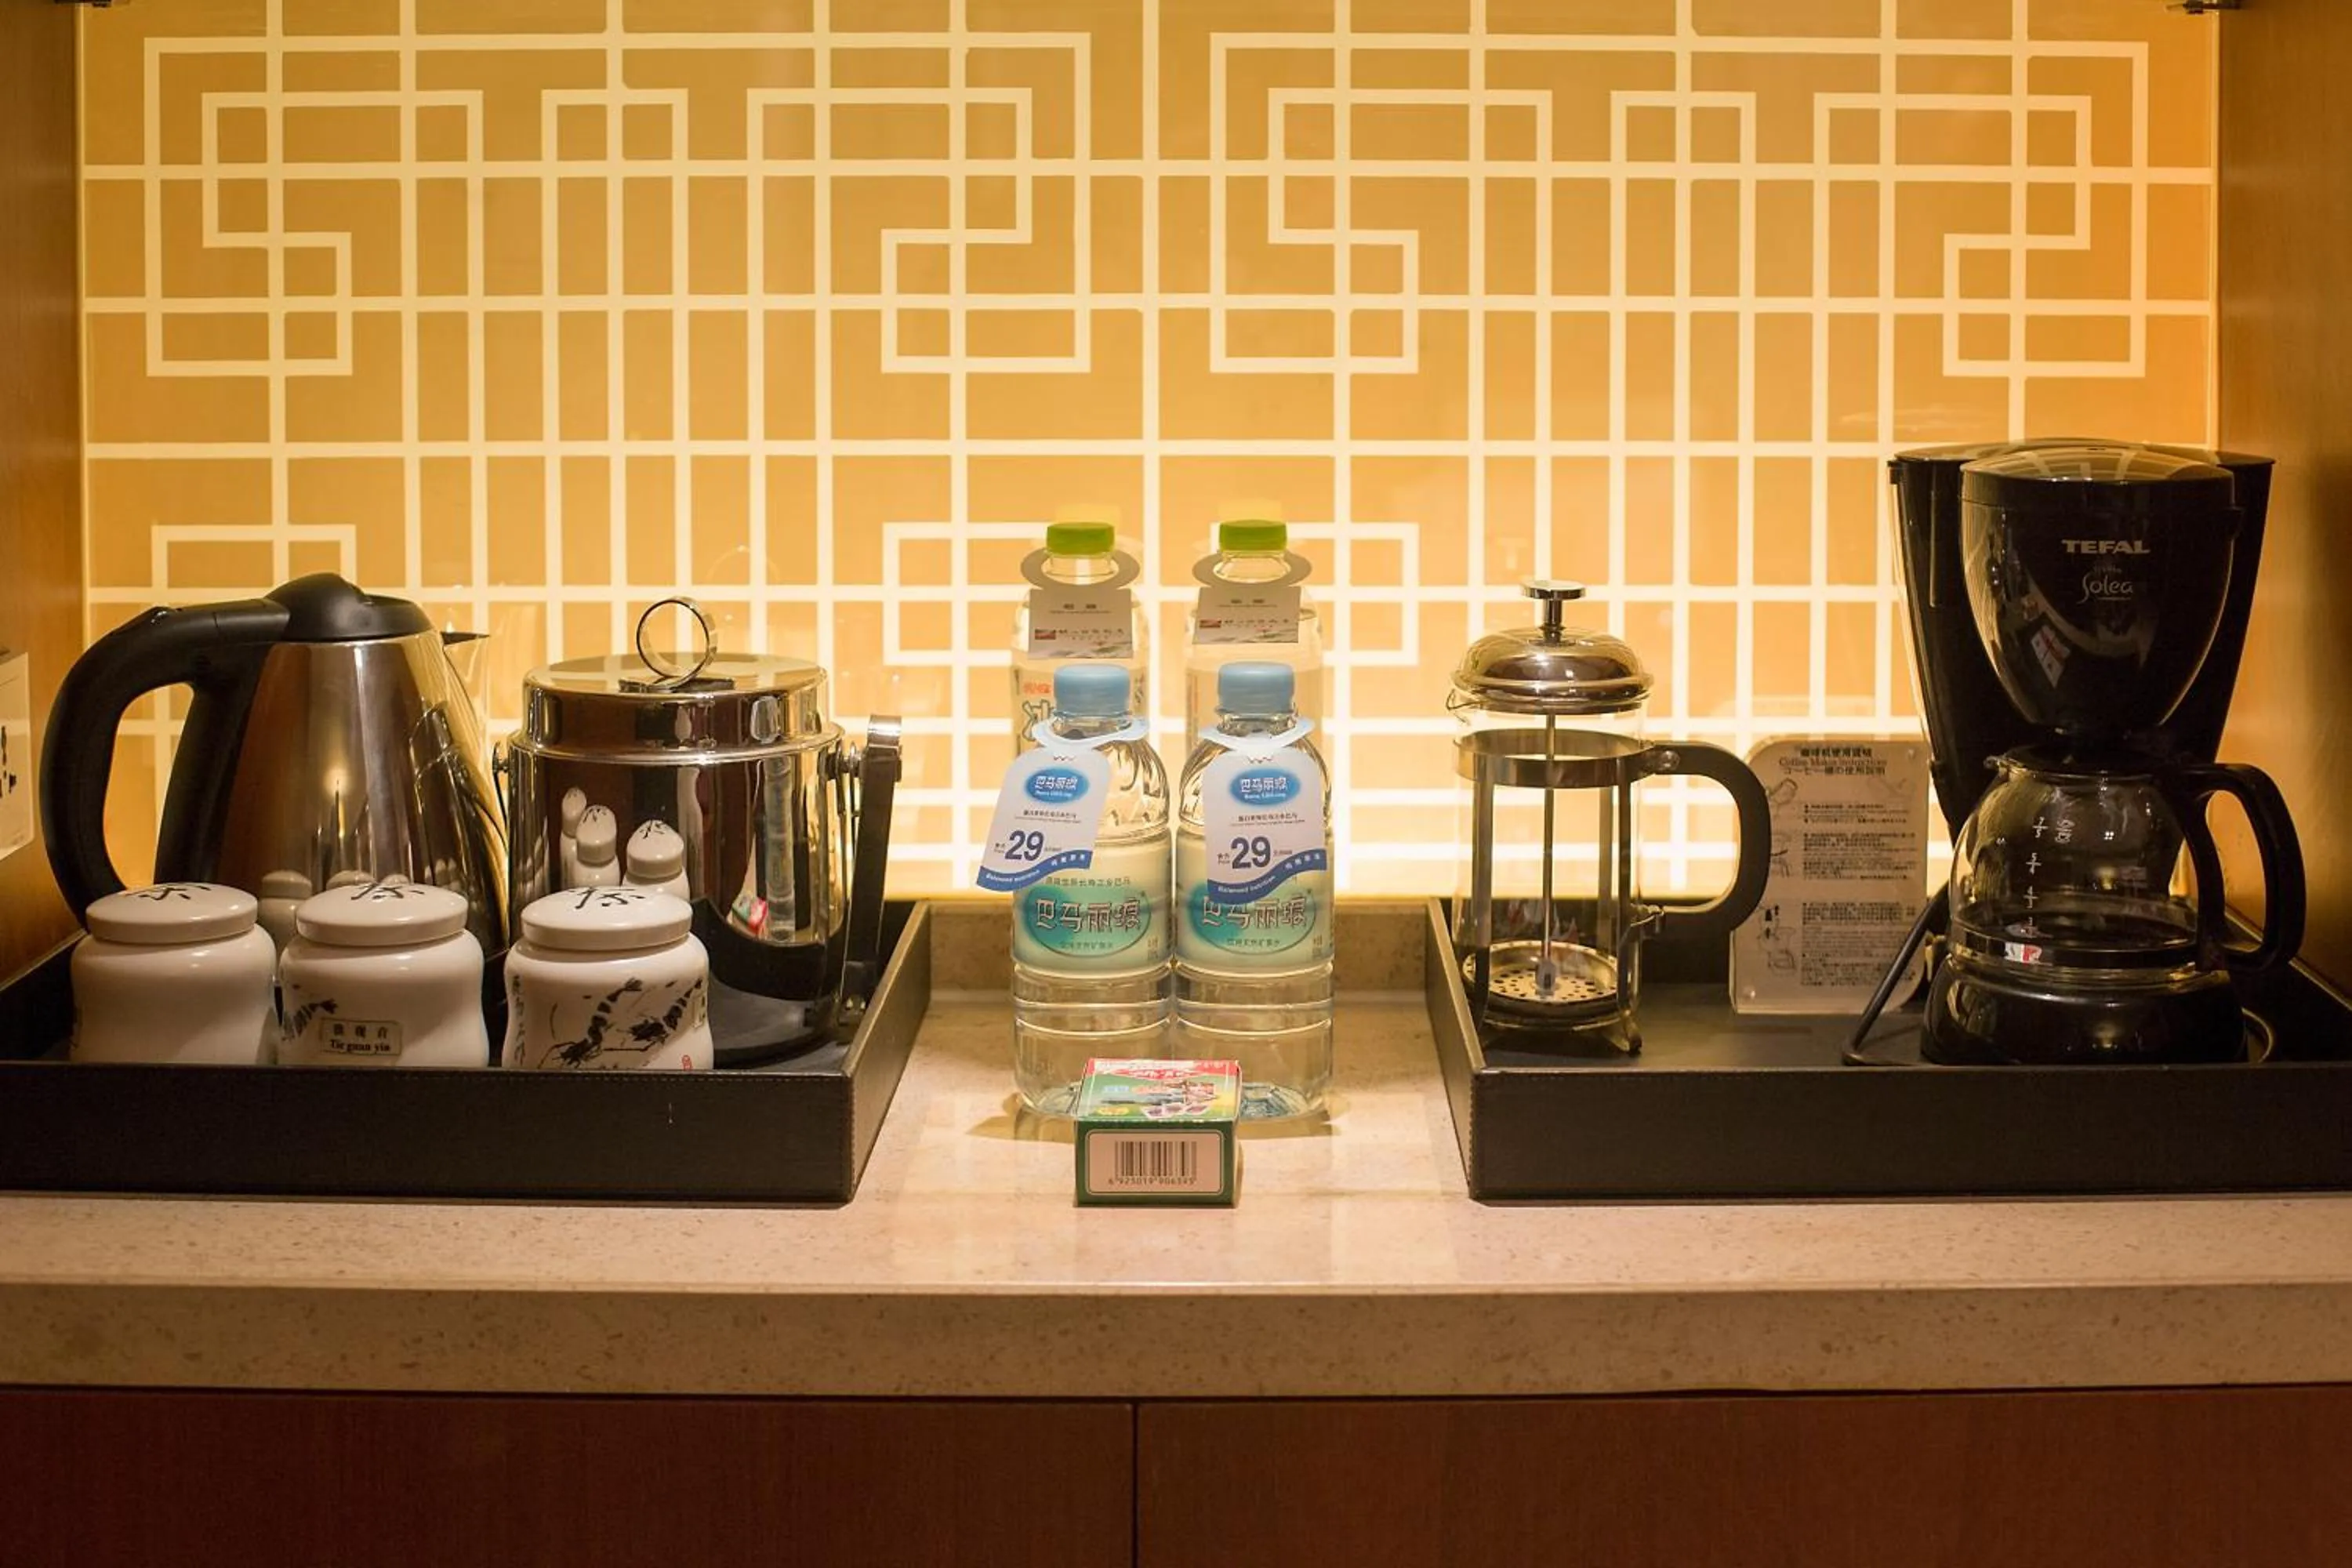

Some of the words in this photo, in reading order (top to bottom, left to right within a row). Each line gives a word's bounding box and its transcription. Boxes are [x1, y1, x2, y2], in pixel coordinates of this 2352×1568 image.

[2061, 539, 2151, 554] TEFAL
[2077, 572, 2133, 604] Solea
[1004, 830, 1044, 861] 29
[1230, 836, 1271, 869] 29
